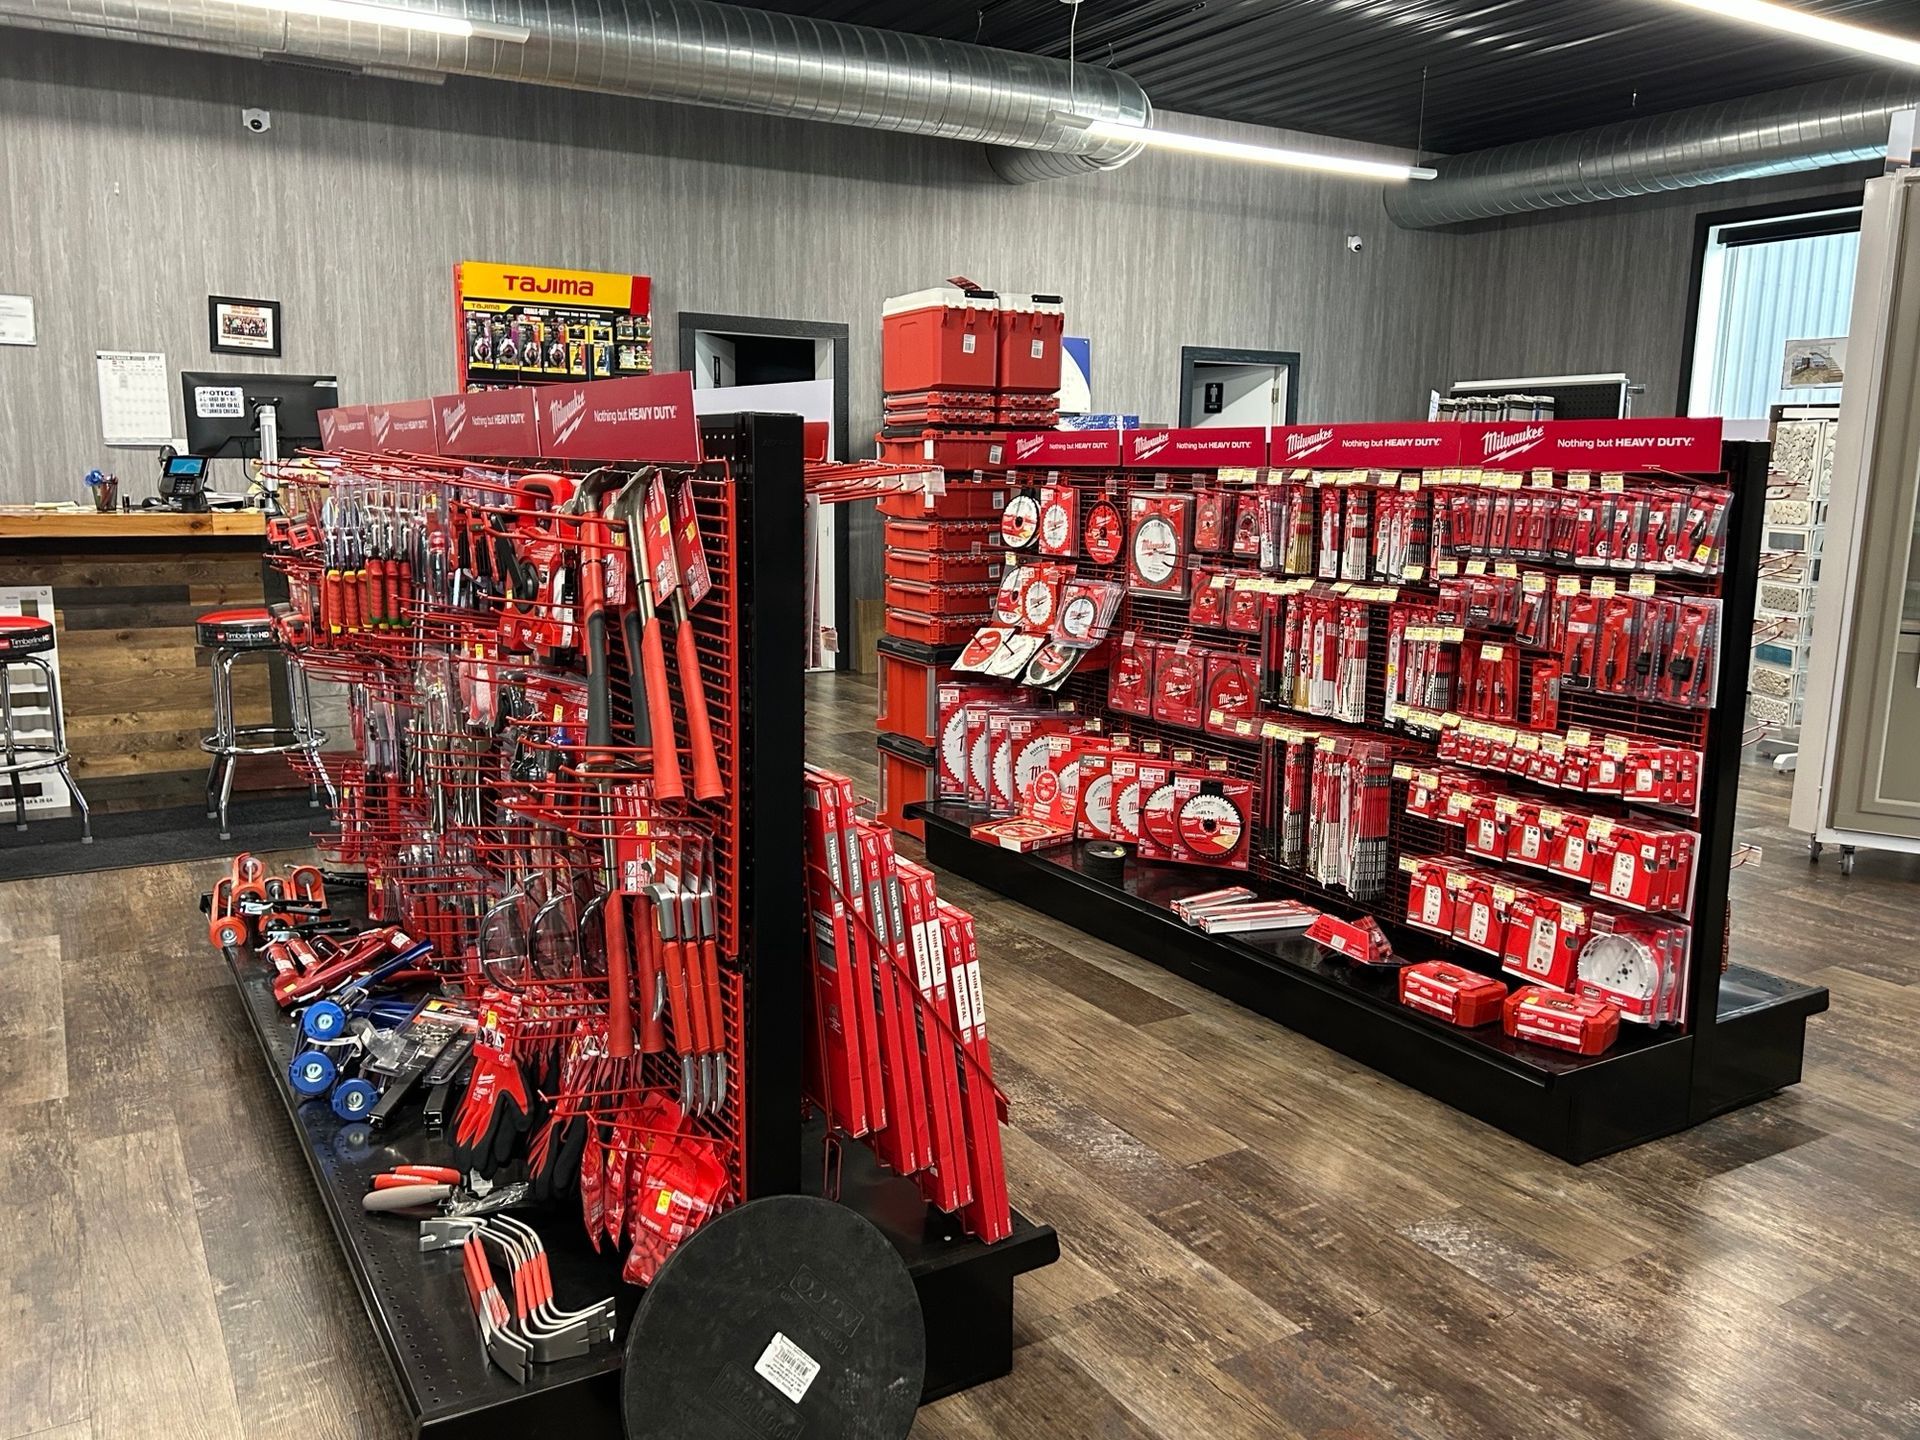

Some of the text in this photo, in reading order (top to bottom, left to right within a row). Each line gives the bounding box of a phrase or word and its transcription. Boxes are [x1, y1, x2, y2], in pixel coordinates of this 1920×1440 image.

[495, 413, 509, 424] HEAVY
[549, 390, 586, 434] Milwaukee
[594, 409, 620, 424] Nothing
[620, 410, 628, 422] but
[628, 406, 652, 419] HEAVY
[1049, 442, 1065, 451] Nothing
[1176, 441, 1197, 451] Nothing
[1198, 441, 1207, 449] but
[1208, 441, 1230, 449] HEAVY
[1285, 427, 1334, 455] Milwaukee
[1342, 439, 1369, 449] Nothing
[1371, 438, 1384, 447] but
[1384, 438, 1414, 446] HEAVY
[1480, 424, 1545, 456] Milwaukee
[1557, 438, 1595, 449] Nothing
[1596, 438, 1614, 447] but
[1615, 437, 1655, 447] HEAVY
[1165, 682, 1192, 694] Milaukee
[1218, 692, 1248, 706] Milaukee
[1424, 674, 1436, 706] TORCH
[829, 838, 838, 867] THICK
[848, 833, 857, 862] THICK
[833, 868, 841, 895] MET
[852, 863, 860, 891] METAL
[873, 886, 884, 916] THICK
[889, 881, 899, 911] THICK
[877, 917, 886, 942] METAL
[893, 911, 903, 937] METAL
[916, 932, 927, 981] THIN METAL
[931, 929, 943, 976] THIN METAL
[956, 975, 968, 1021] THIN METAL
[971, 970, 982, 1017] THIN METAL
